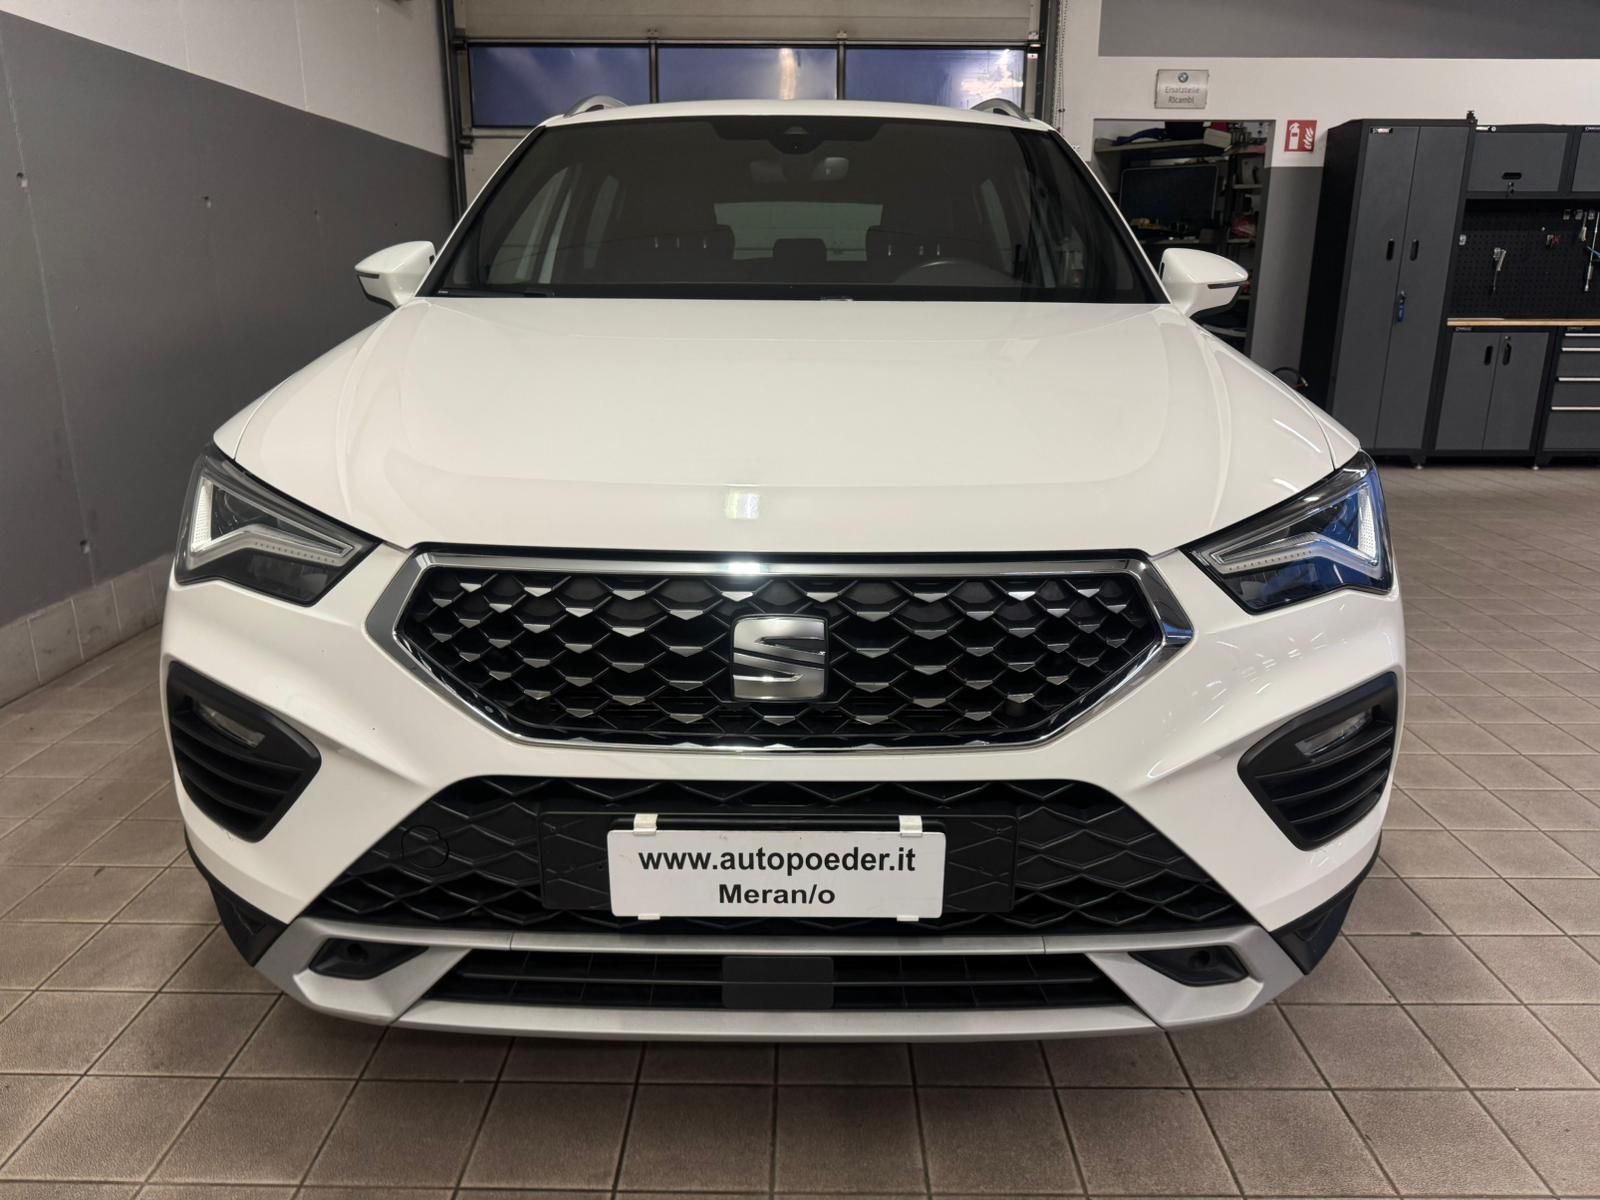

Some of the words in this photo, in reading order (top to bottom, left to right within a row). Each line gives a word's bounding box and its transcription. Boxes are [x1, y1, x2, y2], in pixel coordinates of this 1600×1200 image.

[1168, 95, 1195, 104] Ricambi
[638, 847, 916, 876] www.autopoeder.it
[718, 884, 836, 904] Meran/o
